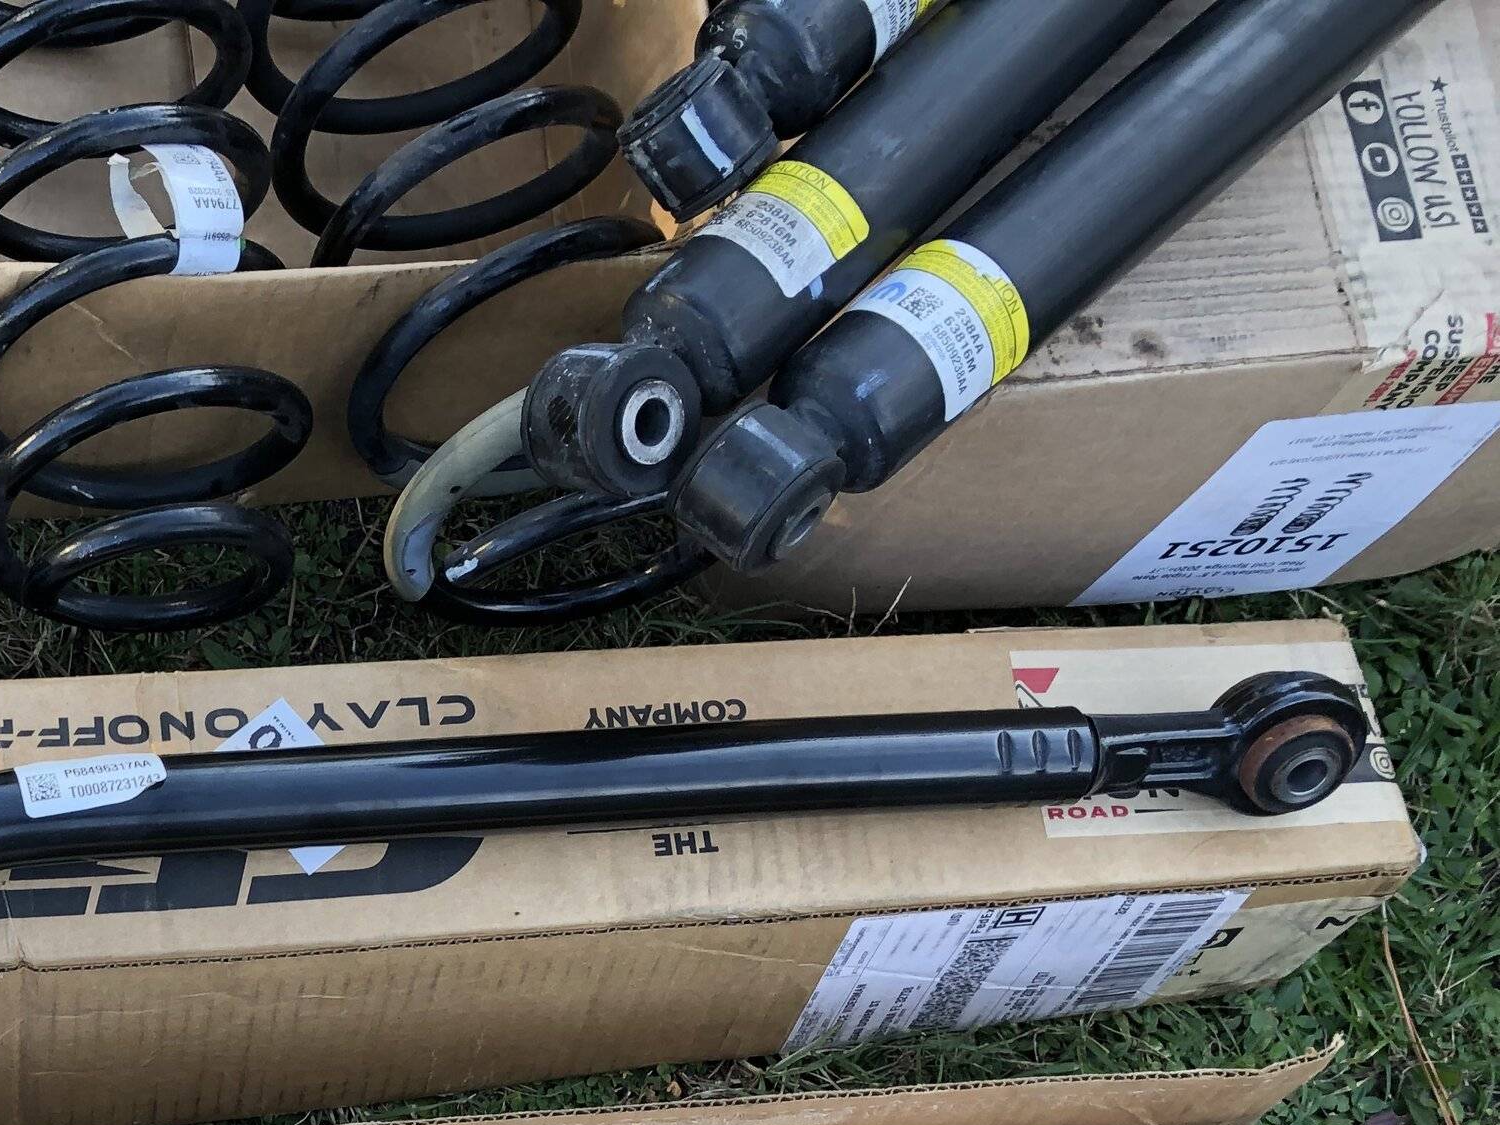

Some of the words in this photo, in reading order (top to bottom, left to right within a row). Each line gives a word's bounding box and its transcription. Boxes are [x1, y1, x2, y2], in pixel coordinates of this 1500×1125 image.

[1435, 96, 1460, 152] Trustpilot
[771, 161, 831, 191] AUTION
[756, 200, 798, 230] 238AA
[944, 316, 977, 373] 63816M
[954, 307, 985, 355] 238AA
[932, 324, 969, 396] 68509238AA
[1375, 330, 1441, 410] COMPANY
[1396, 314, 1464, 408] SUSPENSIO
[1434, 356, 1475, 392] JEEP
[1158, 533, 1349, 560] 1510251
[584, 699, 747, 730] COMPANY
[1047, 804, 1130, 820] ROAD
[651, 830, 720, 857] THE
